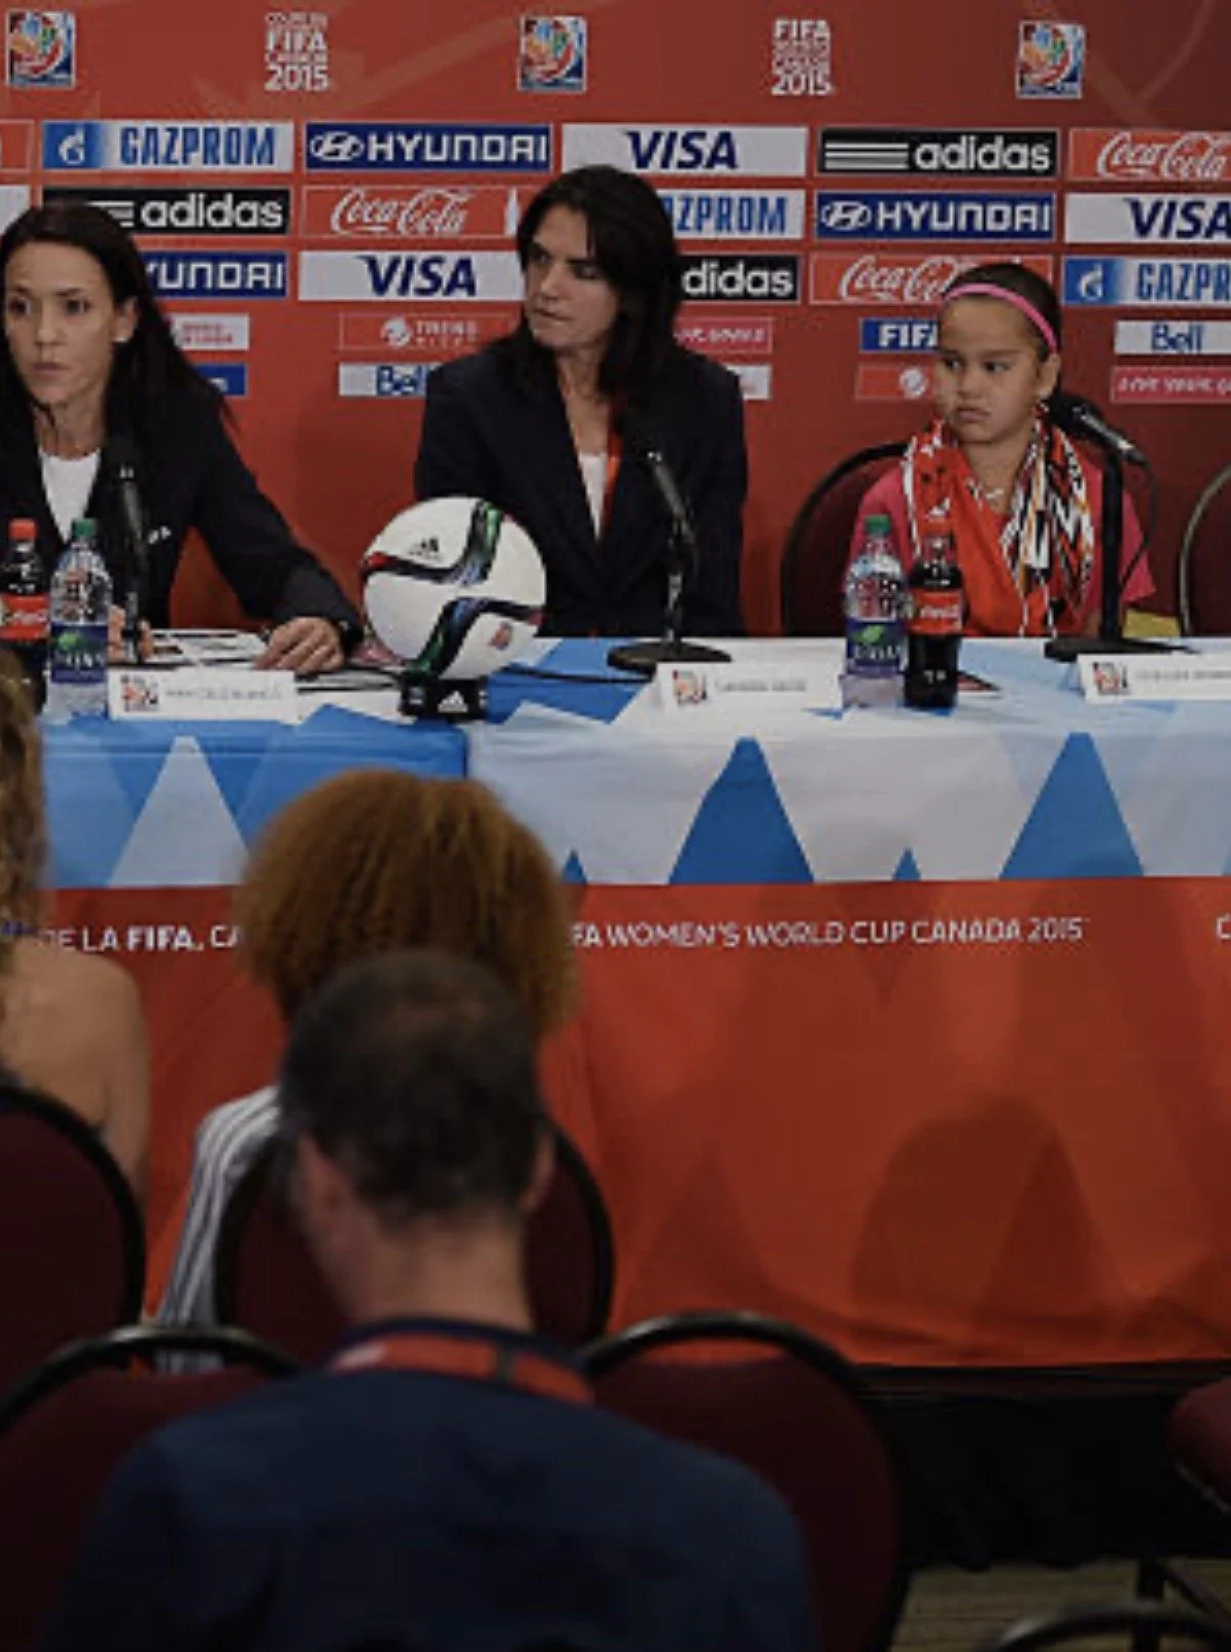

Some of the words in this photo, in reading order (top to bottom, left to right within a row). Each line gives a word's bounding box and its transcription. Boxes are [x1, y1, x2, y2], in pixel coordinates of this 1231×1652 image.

[774, 19, 830, 39] FIFA
[264, 65, 331, 91] 2015
[771, 71, 832, 96] 2015
[120, 127, 274, 165] GAZPROM
[367, 131, 547, 162] HYUNDAI
[628, 131, 738, 169] VISA
[915, 136, 1051, 170] adidas
[141, 193, 284, 228] adidas
[660, 195, 787, 233] ZPROM
[877, 200, 1050, 231] HYUNDAI
[1122, 198, 1231, 239] VISA
[146, 261, 283, 290] UNDAI
[360, 256, 476, 297] VISA
[682, 260, 796, 296] didas
[1136, 262, 1231, 300] GAZPR
[1151, 322, 1203, 351] Bell
[83, 926, 120, 951] LA
[607, 921, 741, 948] WOMEN'S
[746, 921, 844, 947] WORLD
[850, 920, 906, 944] CUP
[911, 919, 1022, 944] CANADA
[1027, 917, 1083, 942] 2015
